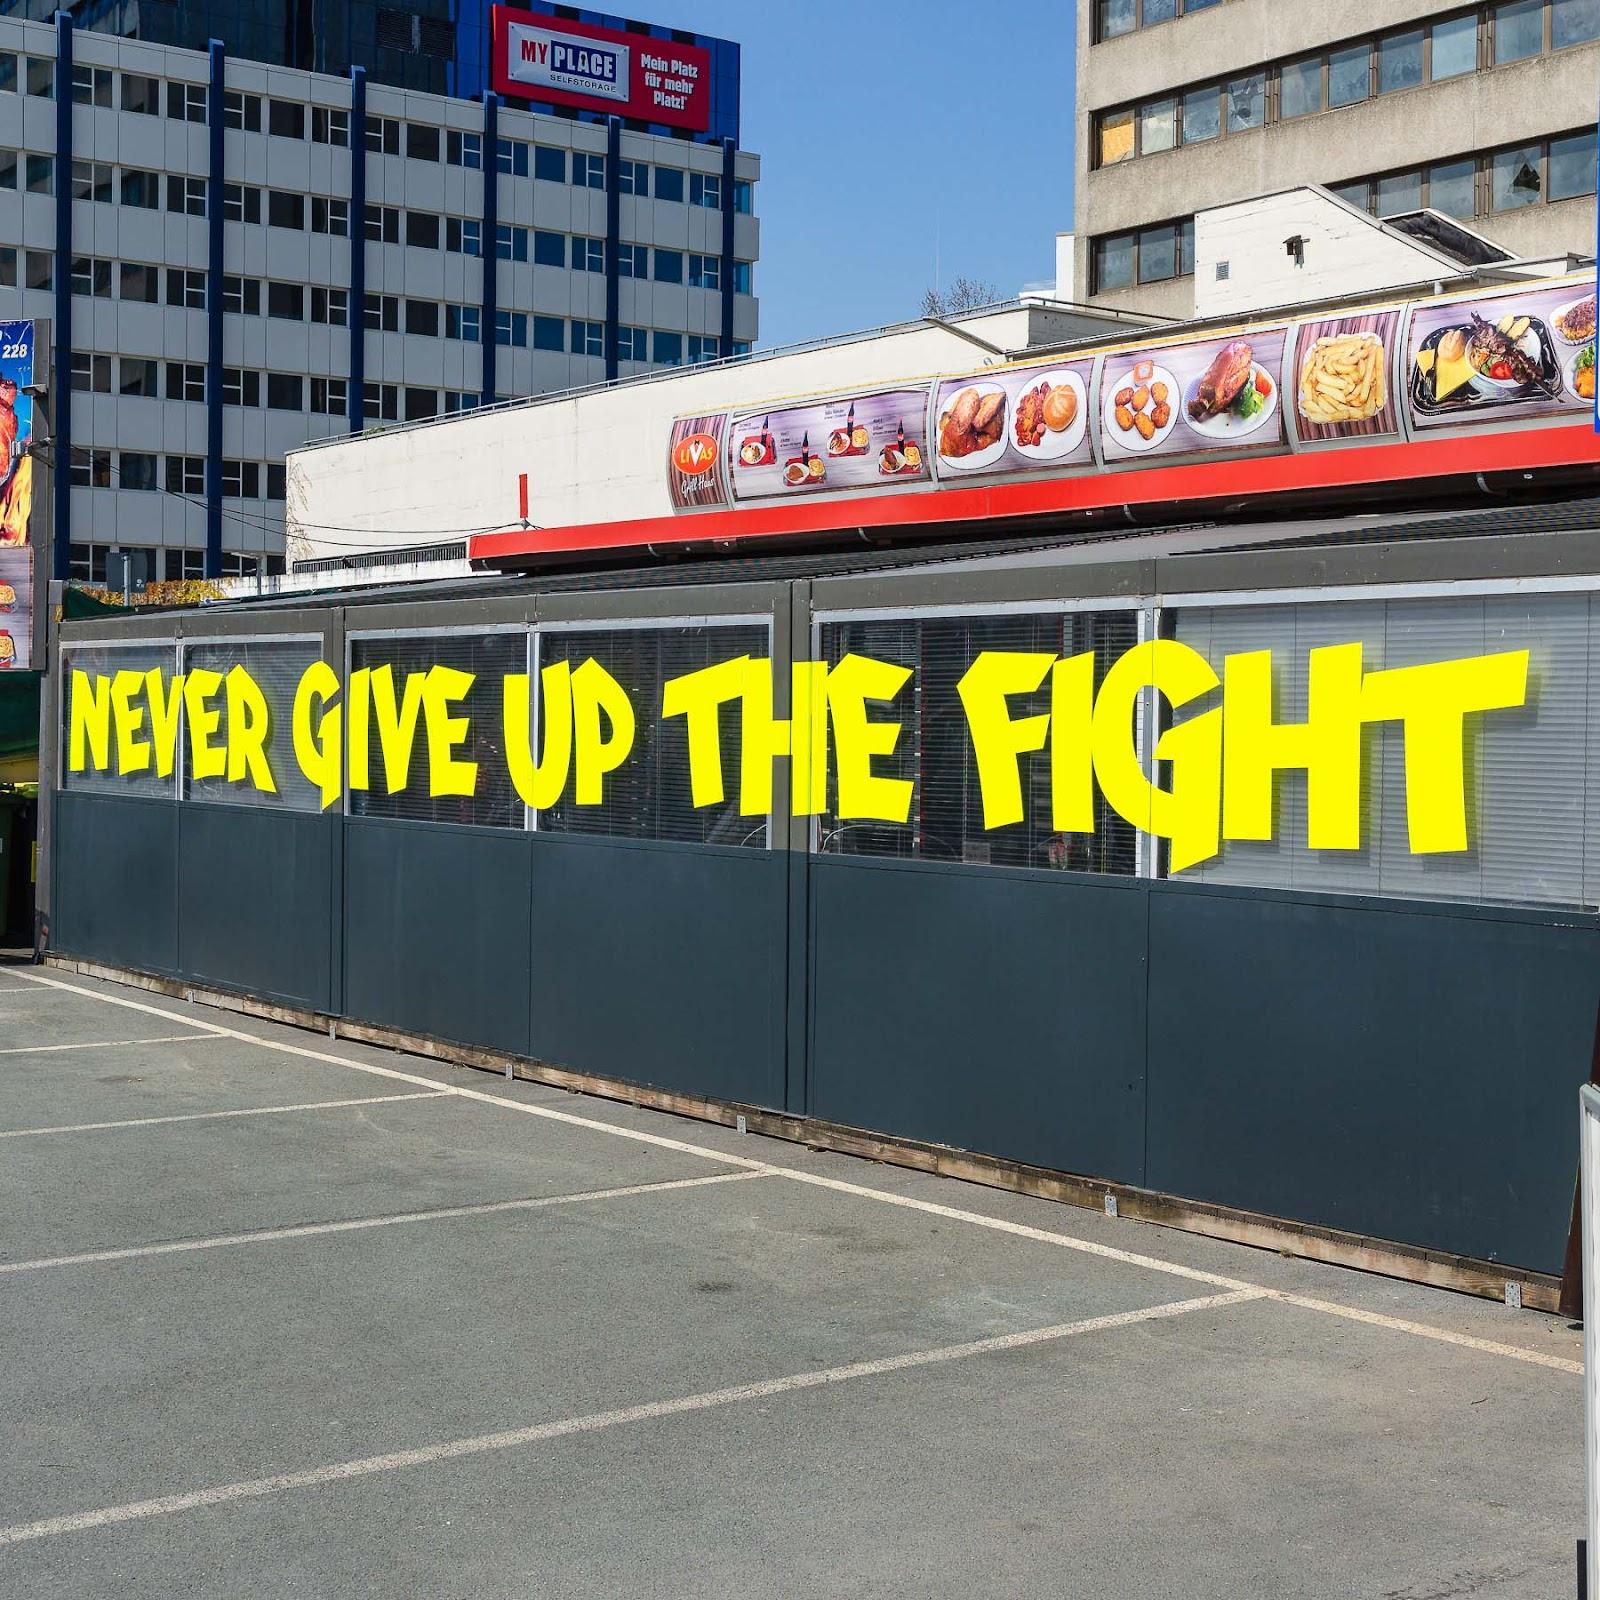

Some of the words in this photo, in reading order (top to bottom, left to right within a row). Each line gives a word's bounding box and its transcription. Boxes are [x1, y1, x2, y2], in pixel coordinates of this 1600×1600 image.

[521, 39, 548, 65] MY
[554, 45, 614, 79] PLACE
[641, 53, 668, 72] Mein
[671, 59, 698, 78] Platz
[550, 74, 617, 93] SELFSTORAGE
[644, 72, 661, 88] für
[664, 78, 694, 94] mehr
[2, 343, 28, 359] 228
[680, 443, 713, 467] LIVAS
[69, 665, 276, 792] NEVER
[292, 661, 478, 808] GIVE
[503, 658, 635, 810] UP
[662, 654, 914, 823] THE
[957, 639, 1530, 872] FIGHT
